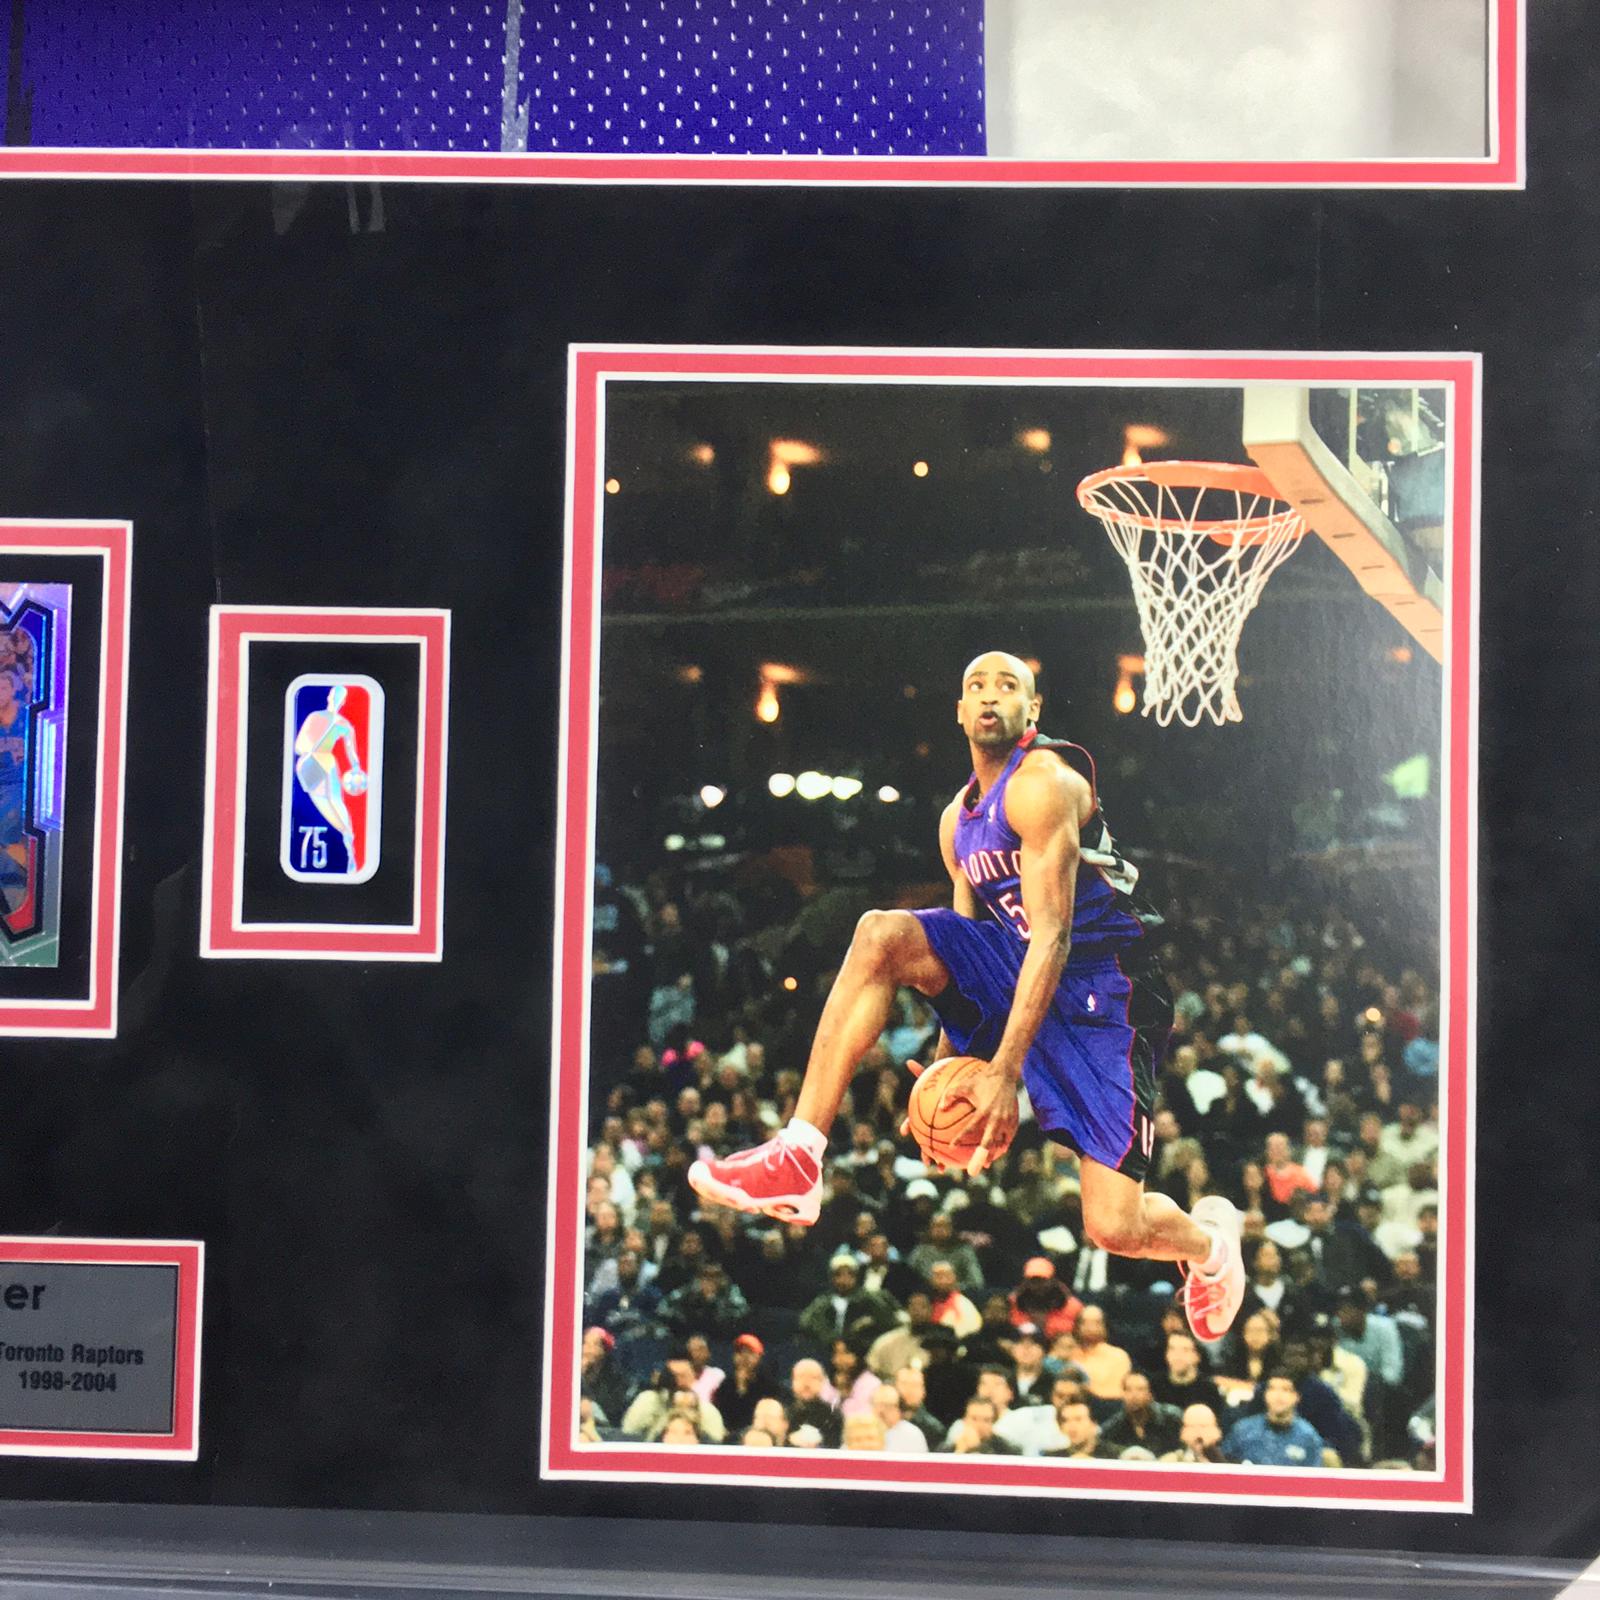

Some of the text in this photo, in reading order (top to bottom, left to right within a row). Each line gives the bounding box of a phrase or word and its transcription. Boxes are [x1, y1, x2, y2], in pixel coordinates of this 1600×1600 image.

[299, 826, 328, 869] 75
[0, 1283, 46, 1310] er
[72, 1344, 144, 1367] Raptors
[19, 1370, 117, 1392] 1998-2004
